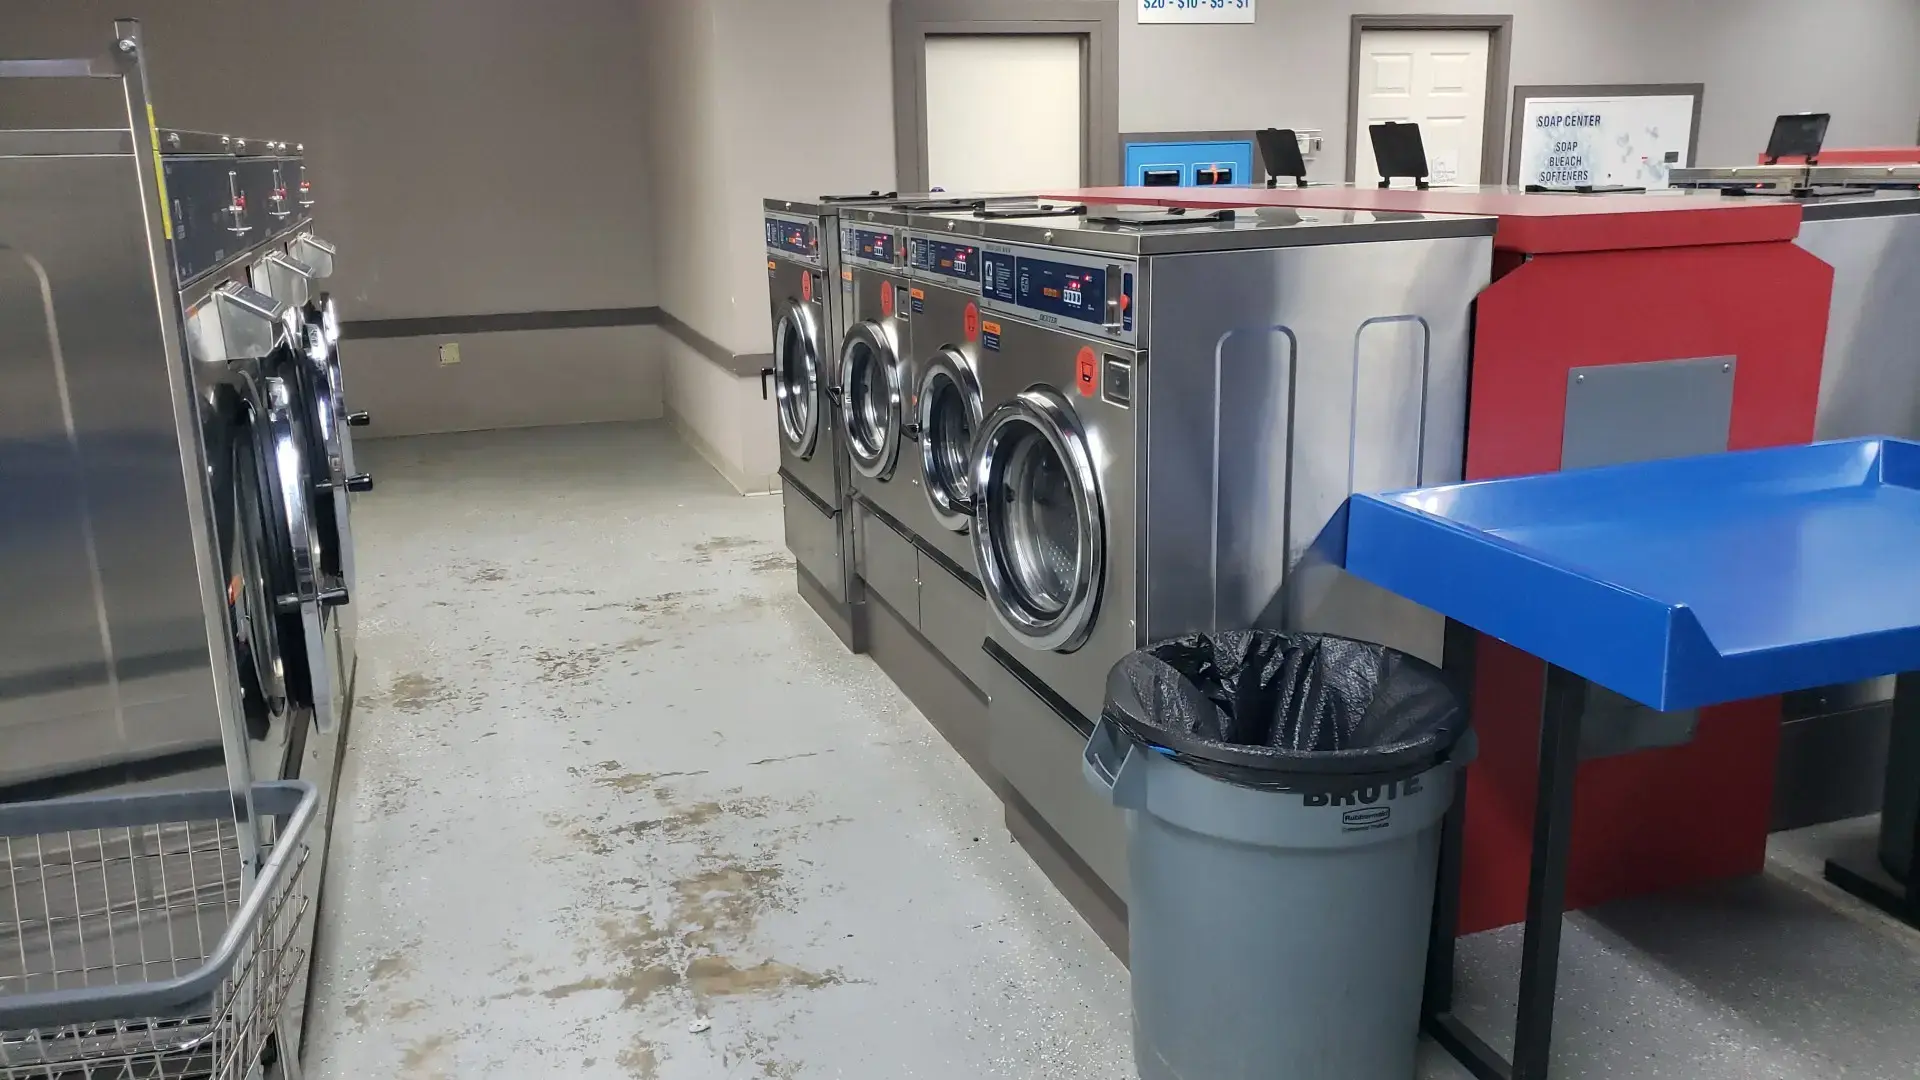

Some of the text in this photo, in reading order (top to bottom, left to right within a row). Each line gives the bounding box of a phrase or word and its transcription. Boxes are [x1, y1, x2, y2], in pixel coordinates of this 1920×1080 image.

[1143, 0, 1165, 10] $20
[1177, 0, 1198, 10] $10
[1537, 115, 1601, 127] SOAP CENTER
[1555, 142, 1578, 152] SOAP
[1549, 156, 1582, 167] BLEACH
[1540, 170, 1589, 182] SOFTENERS
